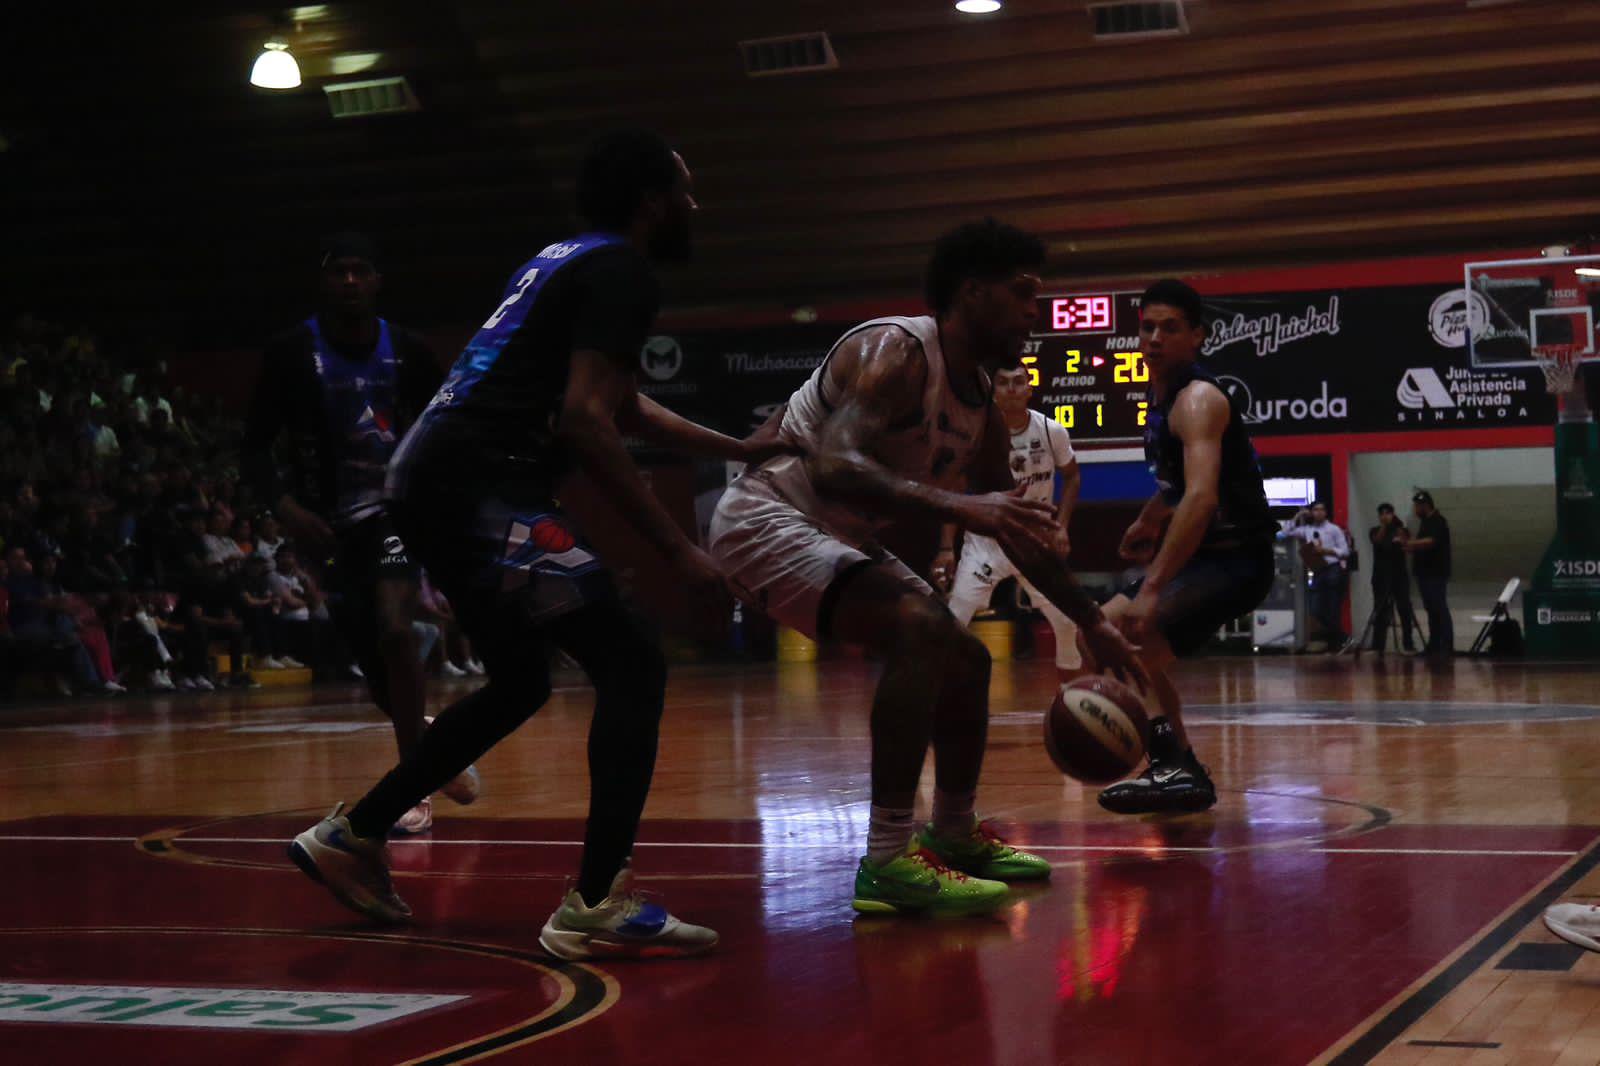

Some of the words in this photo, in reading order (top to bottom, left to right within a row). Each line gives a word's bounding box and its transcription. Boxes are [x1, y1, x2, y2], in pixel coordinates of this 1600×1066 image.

[481, 267, 540, 329] 2
[1052, 297, 1110, 330] 6:39
[1253, 296, 1340, 356] Huichol
[1105, 336, 1140, 349] HOM
[1065, 350, 1081, 373] 2
[1113, 352, 1149, 383] 20
[1051, 375, 1096, 387] PERIOD
[1445, 366, 1486, 380] Jun
[1449, 376, 1527, 394] Asistencia
[1126, 392, 1147, 401] FOU
[1456, 392, 1512, 408] Privada
[1054, 404, 1075, 428] 10
[1096, 403, 1103, 427] 1
[1397, 407, 1529, 424] SINALOA
[1567, 560, 1600, 576] ISD
